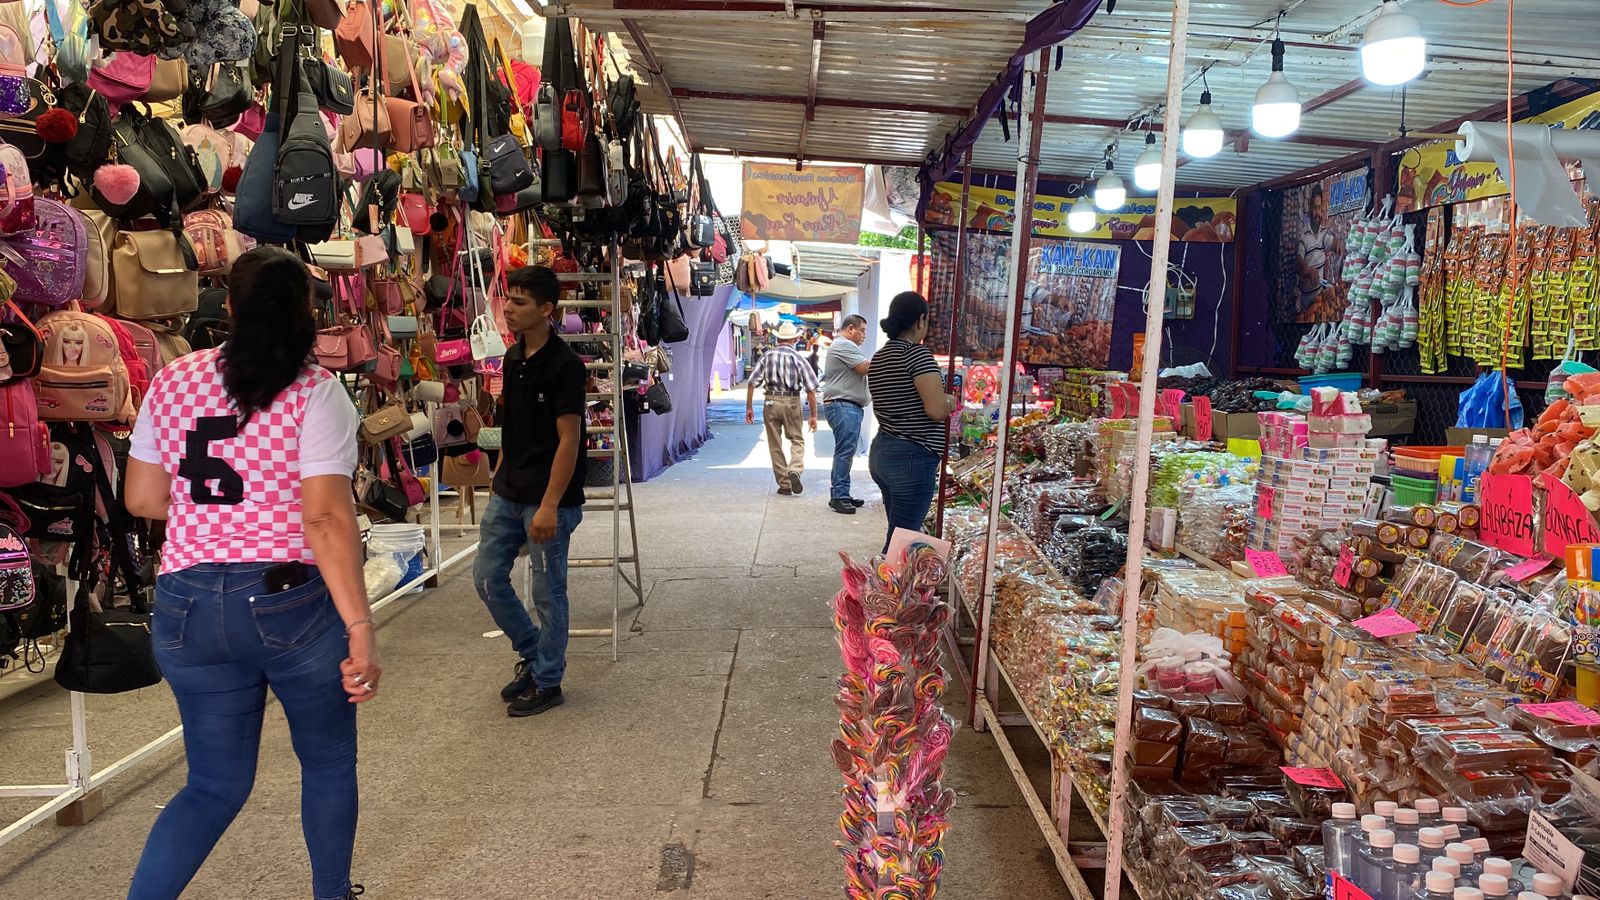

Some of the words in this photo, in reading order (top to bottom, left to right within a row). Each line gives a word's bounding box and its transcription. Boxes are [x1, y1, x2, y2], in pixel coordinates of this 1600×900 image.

[290, 176, 305, 184] NIKE
[292, 192, 314, 204] NIKE
[1040, 243, 1118, 270] KAN-KAN
[178, 415, 244, 505] 5
